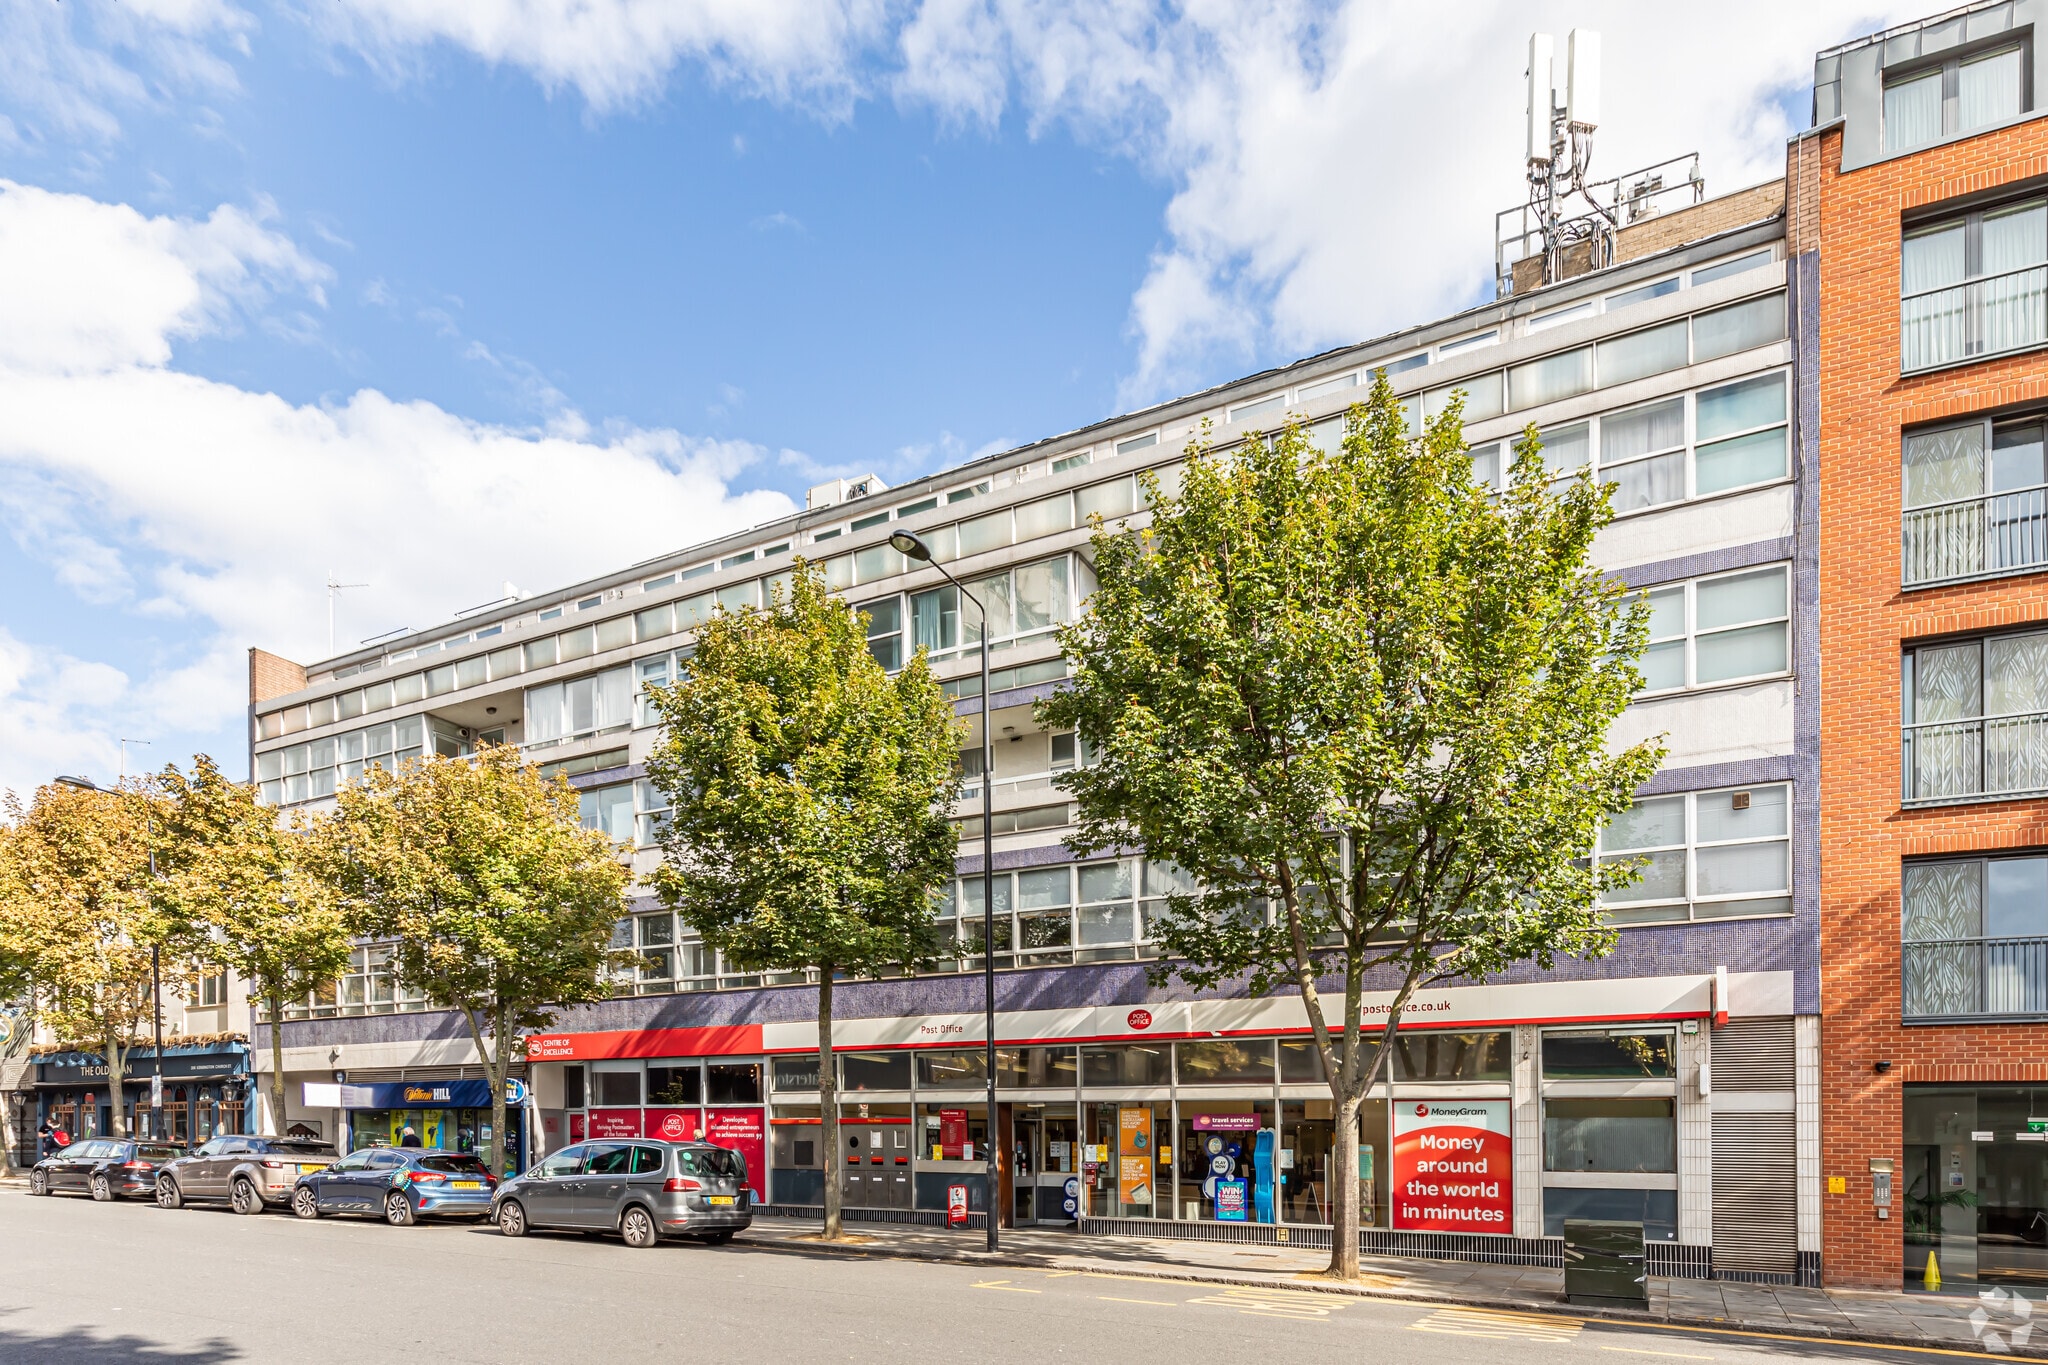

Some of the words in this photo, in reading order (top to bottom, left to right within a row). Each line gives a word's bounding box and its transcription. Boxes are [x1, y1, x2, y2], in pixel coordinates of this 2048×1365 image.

[921, 1026, 938, 1034] Post
[940, 1024, 963, 1034] Office
[543, 1048, 574, 1056] EXCELLENCE
[80, 1066, 94, 1077] THE
[94, 1065, 109, 1076] OLD
[433, 1088, 450, 1100] HILL
[1431, 1108, 1487, 1117] MoneyGram
[722, 1116, 747, 1124] Developing
[1420, 1134, 1484, 1154] Money
[1417, 1158, 1488, 1174] around
[1222, 1187, 1240, 1195] WIN
[1406, 1180, 1439, 1196] the
[1442, 1182, 1499, 1198] world
[1402, 1203, 1420, 1218] in
[1424, 1204, 1504, 1222] minutes
